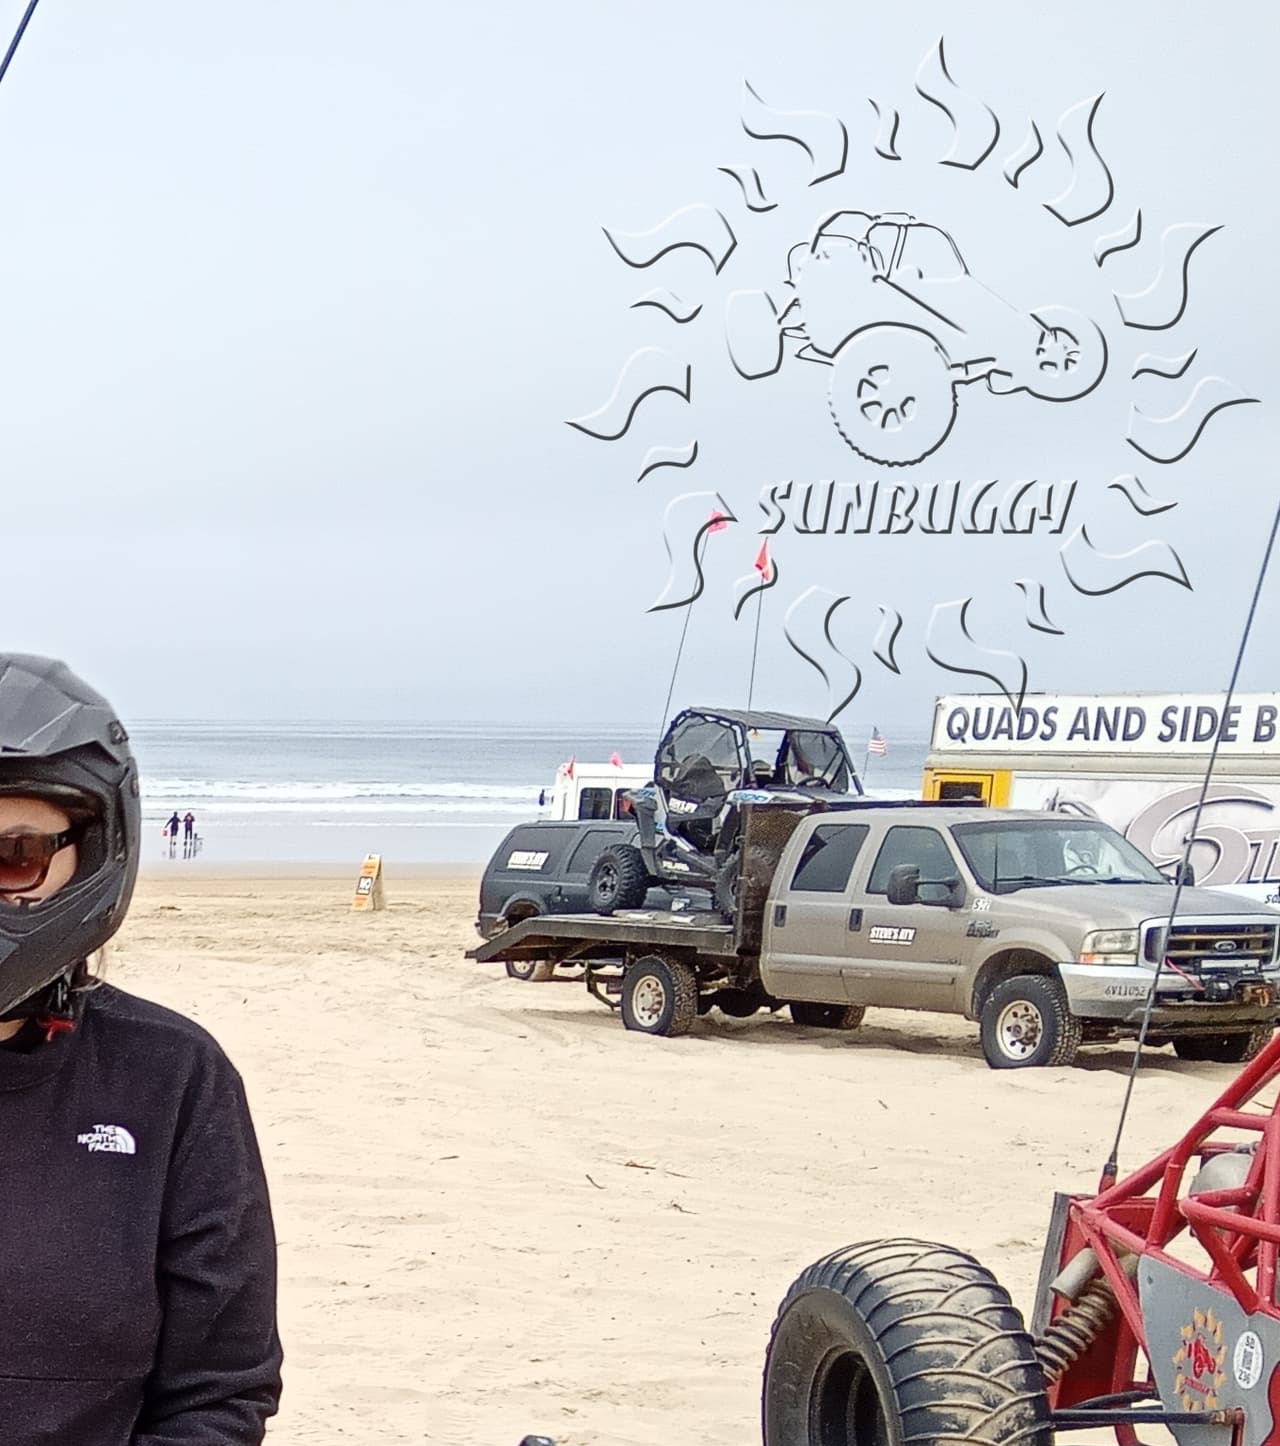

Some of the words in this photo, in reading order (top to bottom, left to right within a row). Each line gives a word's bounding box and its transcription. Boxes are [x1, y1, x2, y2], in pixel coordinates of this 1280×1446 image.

[946, 705, 1059, 744] QUADS
[1066, 705, 1148, 742] AND
[1157, 704, 1242, 743] SIDE
[92, 1124, 116, 1135] THE
[77, 1132, 117, 1145] NORTH
[88, 1142, 118, 1153] FACE
